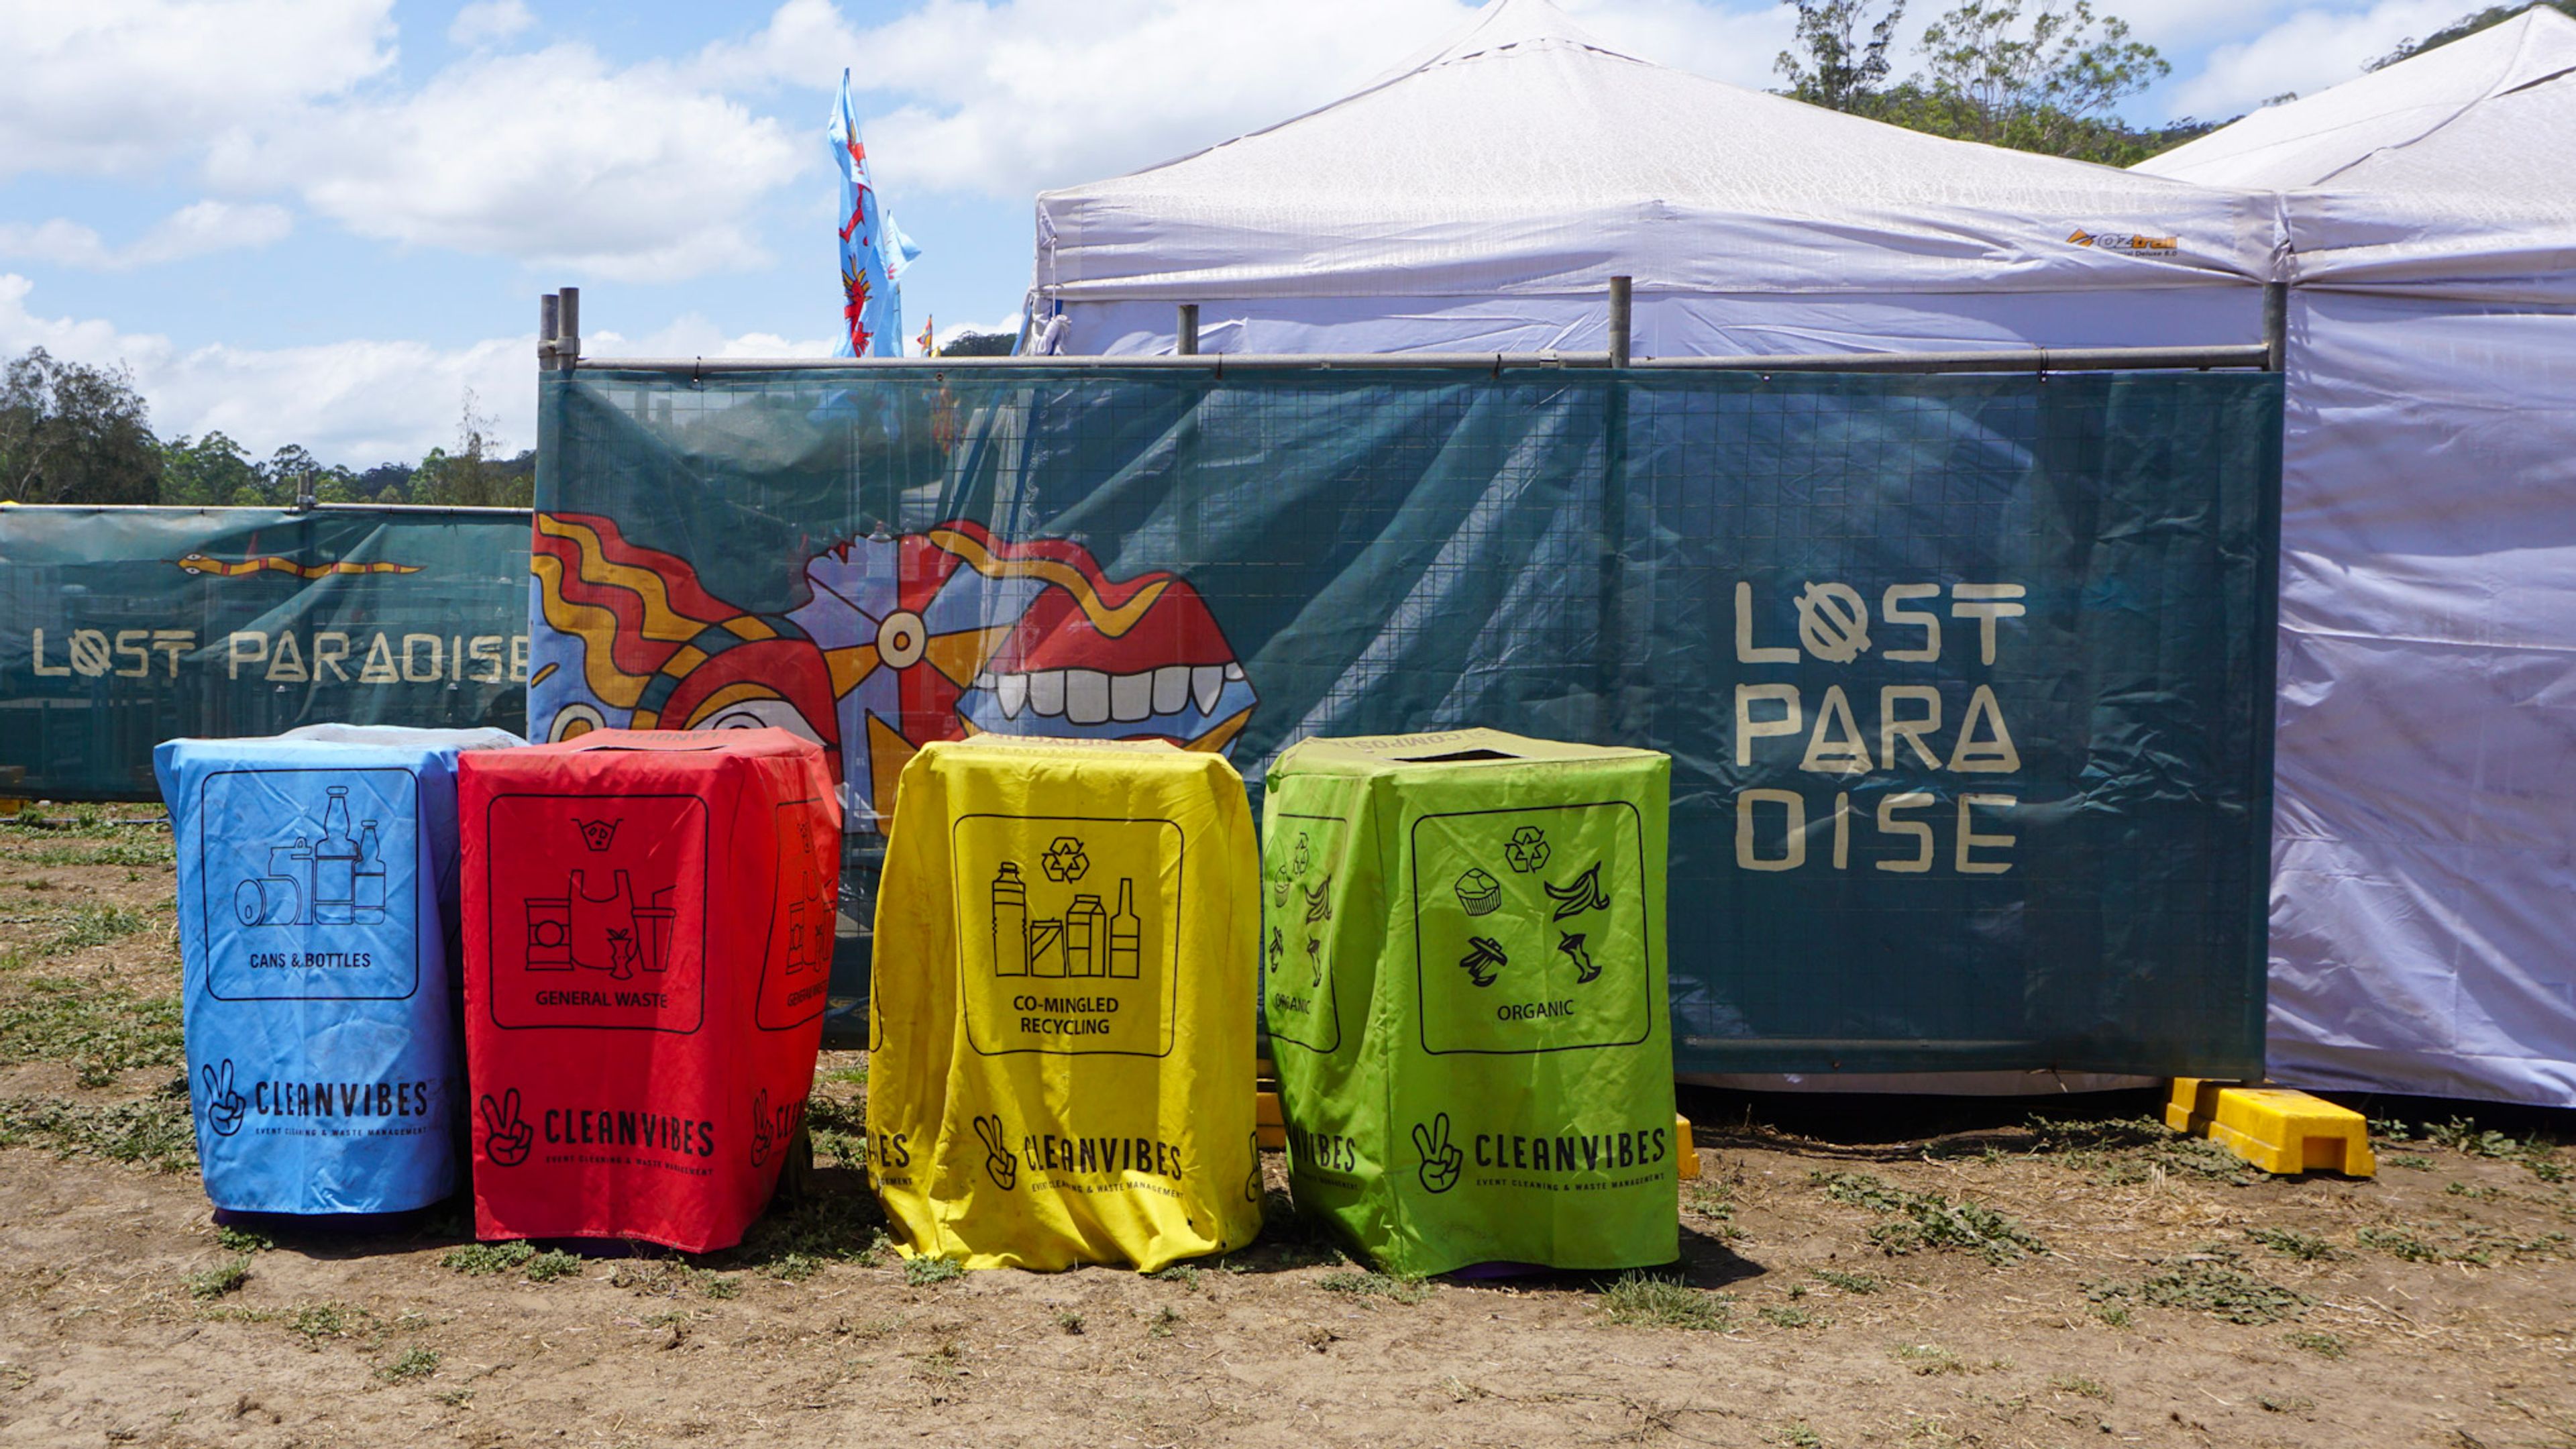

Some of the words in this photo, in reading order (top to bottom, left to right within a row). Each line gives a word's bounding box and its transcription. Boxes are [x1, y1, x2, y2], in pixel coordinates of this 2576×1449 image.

[1735, 582, 2026, 665] LOST
[33, 628, 197, 678] LOST
[229, 631, 529, 684] PARADISE
[1735, 684, 2021, 773] PARA
[250, 953, 286, 968] CANS
[291, 953, 301, 968] &
[305, 953, 371, 968] BOTTLES
[535, 991, 611, 1006] GENERAL
[615, 992, 669, 1008] WASTE
[1014, 996, 1119, 1013] CO-MINGLED
[1497, 999, 1574, 1020] ORGANIC
[1021, 1018, 1110, 1034] RECYCLING
[256, 1081, 427, 1117] CLEANVIBES
[545, 1109, 714, 1157] CLEANVIBES
[1024, 1134, 1182, 1181] CLEANVIBES
[1476, 1128, 1665, 1171] CLEANVIBES
[1097, 1183, 1124, 1193] WASTE
[1126, 1181, 1184, 1199] MANAGEMENT
[1512, 1180, 1559, 1191] CLEANING
[1575, 1182, 1607, 1191] WASTE
